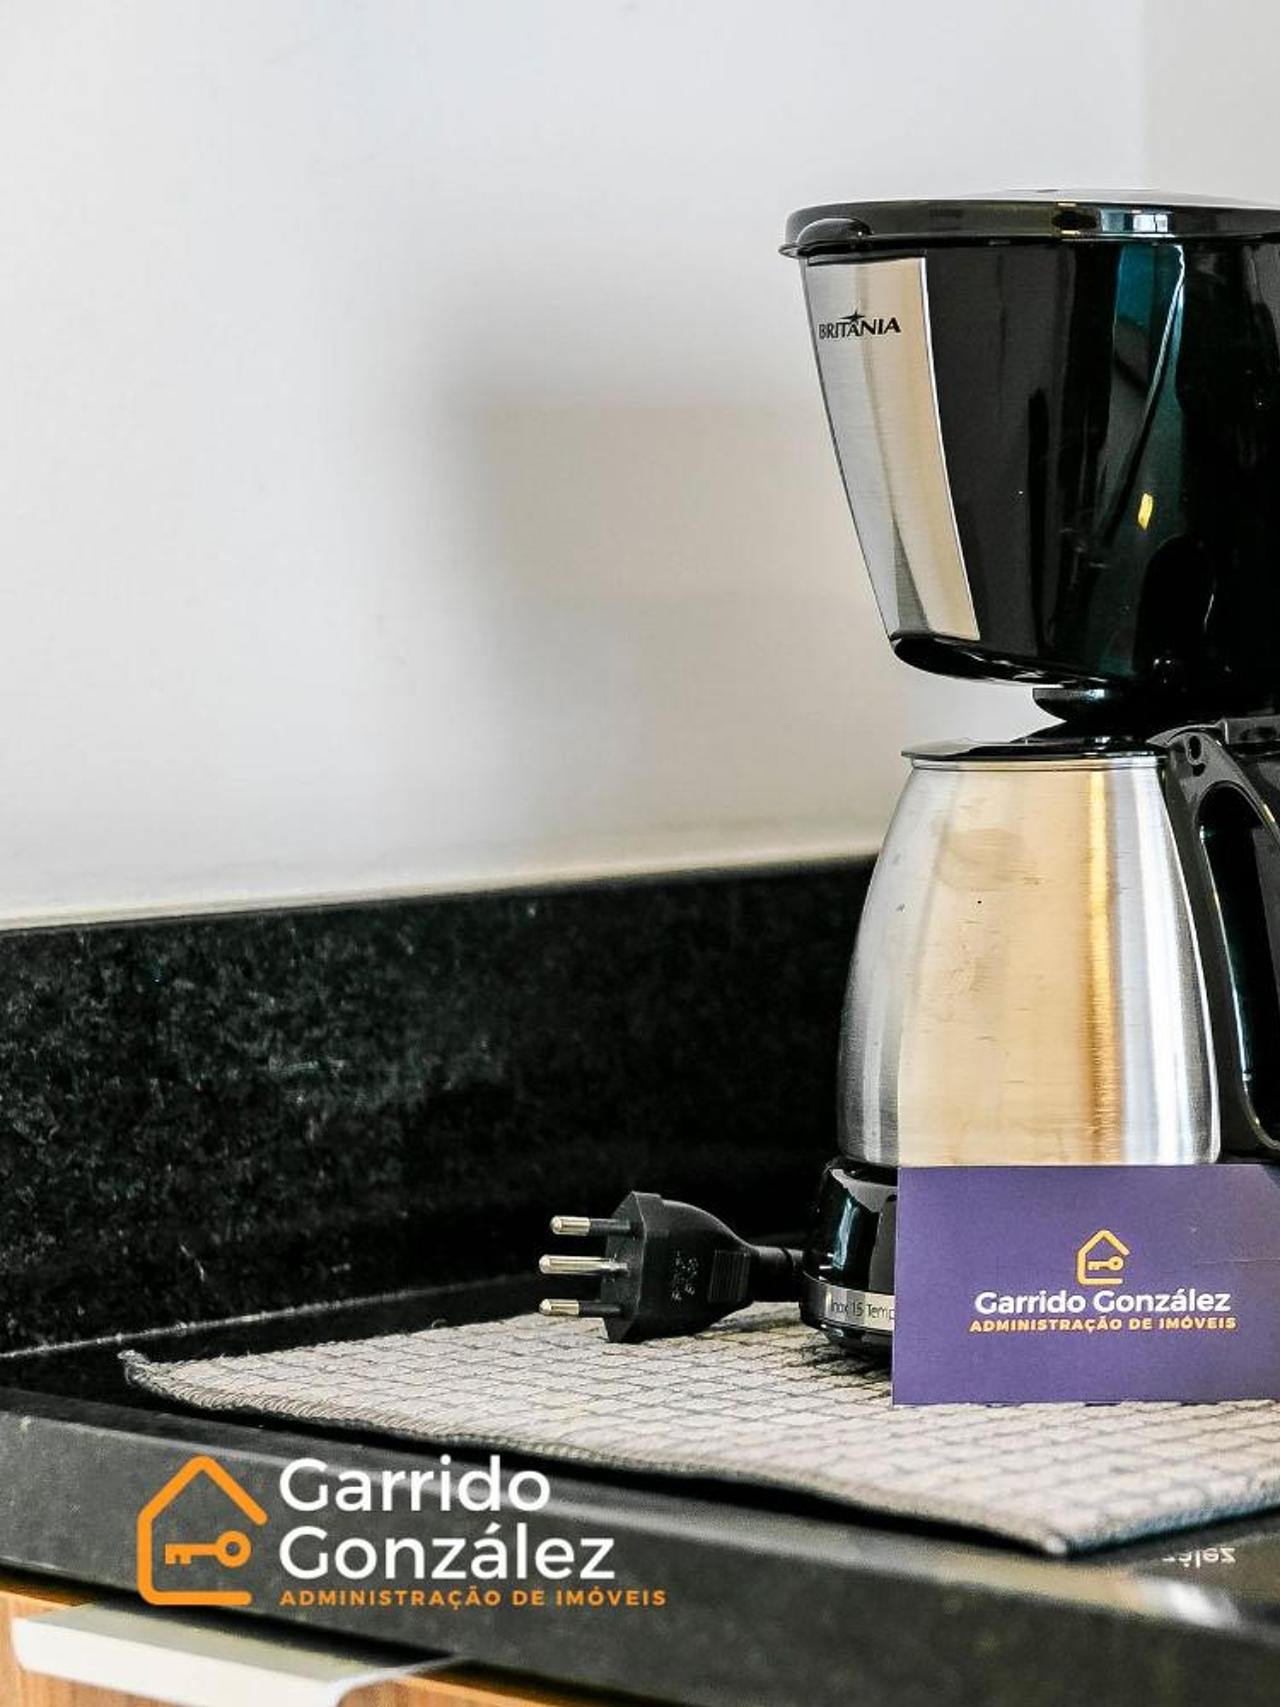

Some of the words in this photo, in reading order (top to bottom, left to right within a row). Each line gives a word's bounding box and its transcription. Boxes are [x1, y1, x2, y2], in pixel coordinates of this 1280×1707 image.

[974, 1289, 1086, 1314] Garrido
[1093, 1288, 1232, 1313] González
[969, 1315, 1122, 1333] ADMINISTRAÇÃO
[1129, 1317, 1153, 1330] DE
[1158, 1315, 1237, 1330] IMÓVEIS
